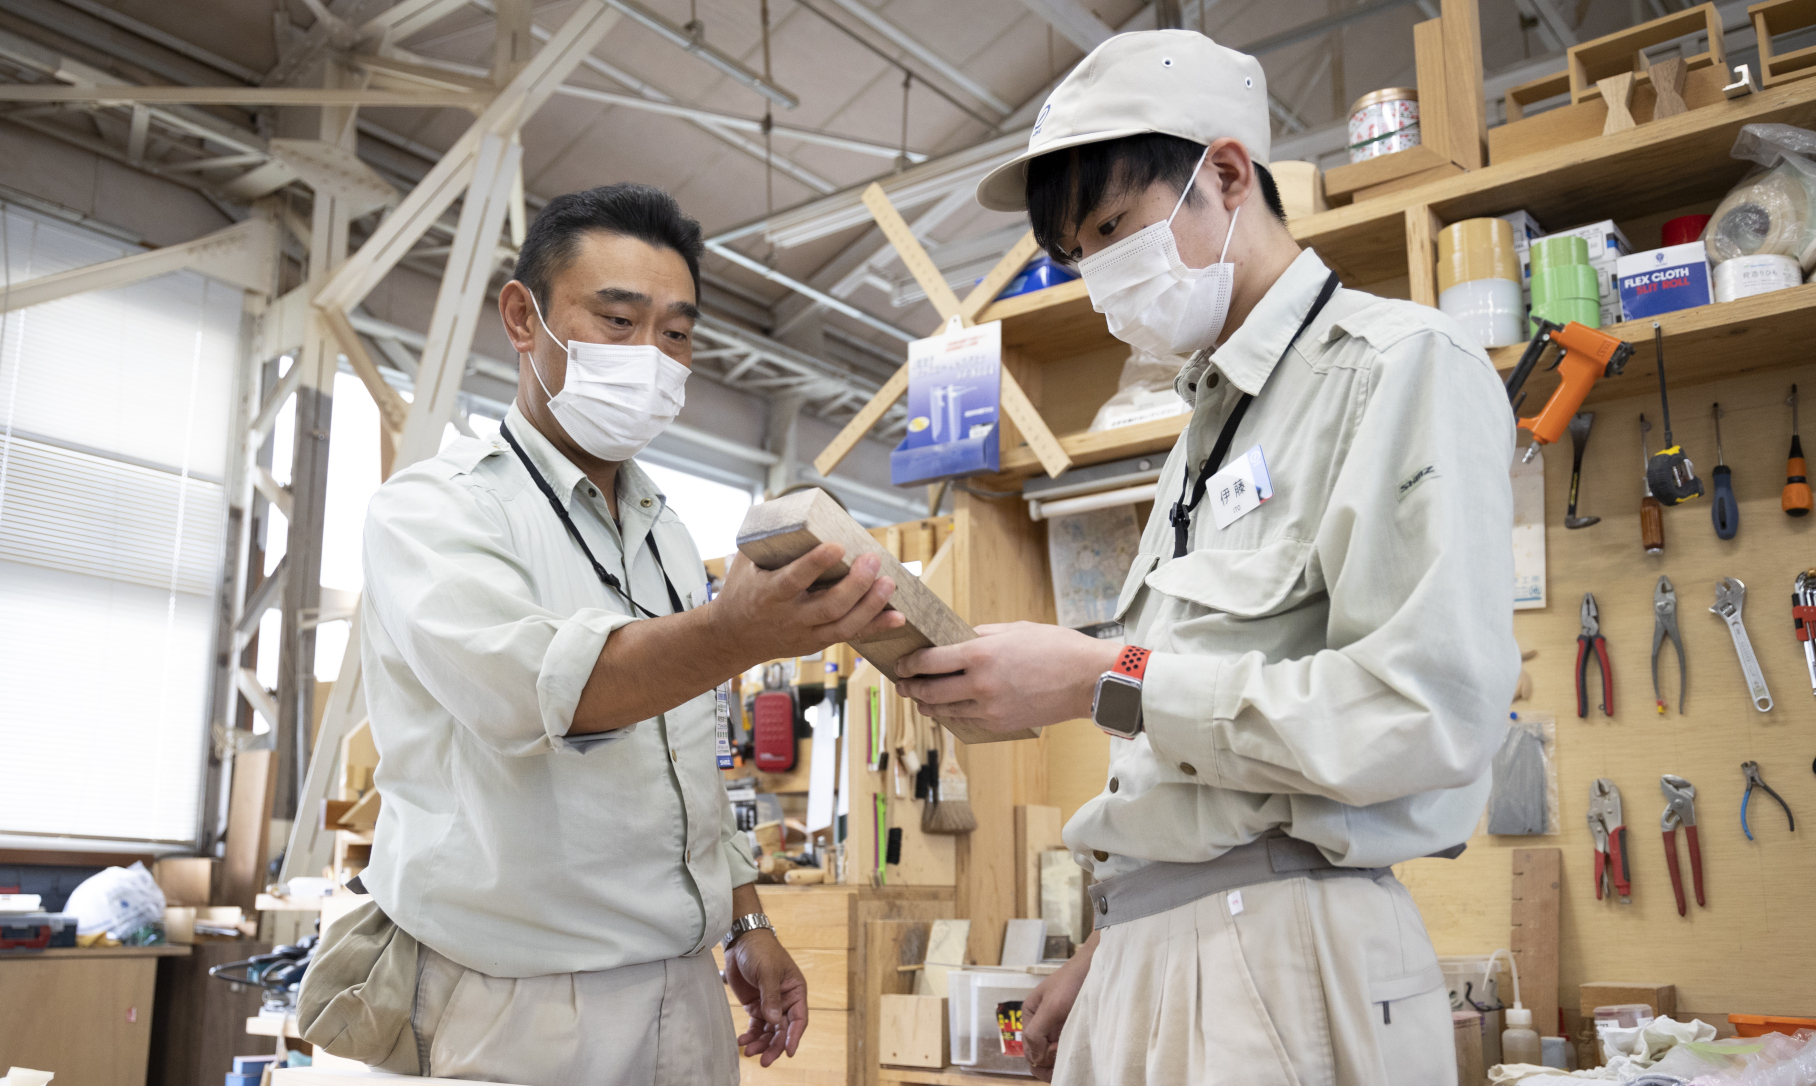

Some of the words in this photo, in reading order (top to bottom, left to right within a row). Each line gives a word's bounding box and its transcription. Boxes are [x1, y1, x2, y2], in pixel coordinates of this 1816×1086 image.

[1624, 274, 1650, 289] FLEX
[1651, 267, 1690, 282] CLOTH
[1636, 282, 1659, 295] SLIT
[1662, 277, 1690, 290] ROLL
[1220, 478, 1246, 507] 伊藤
